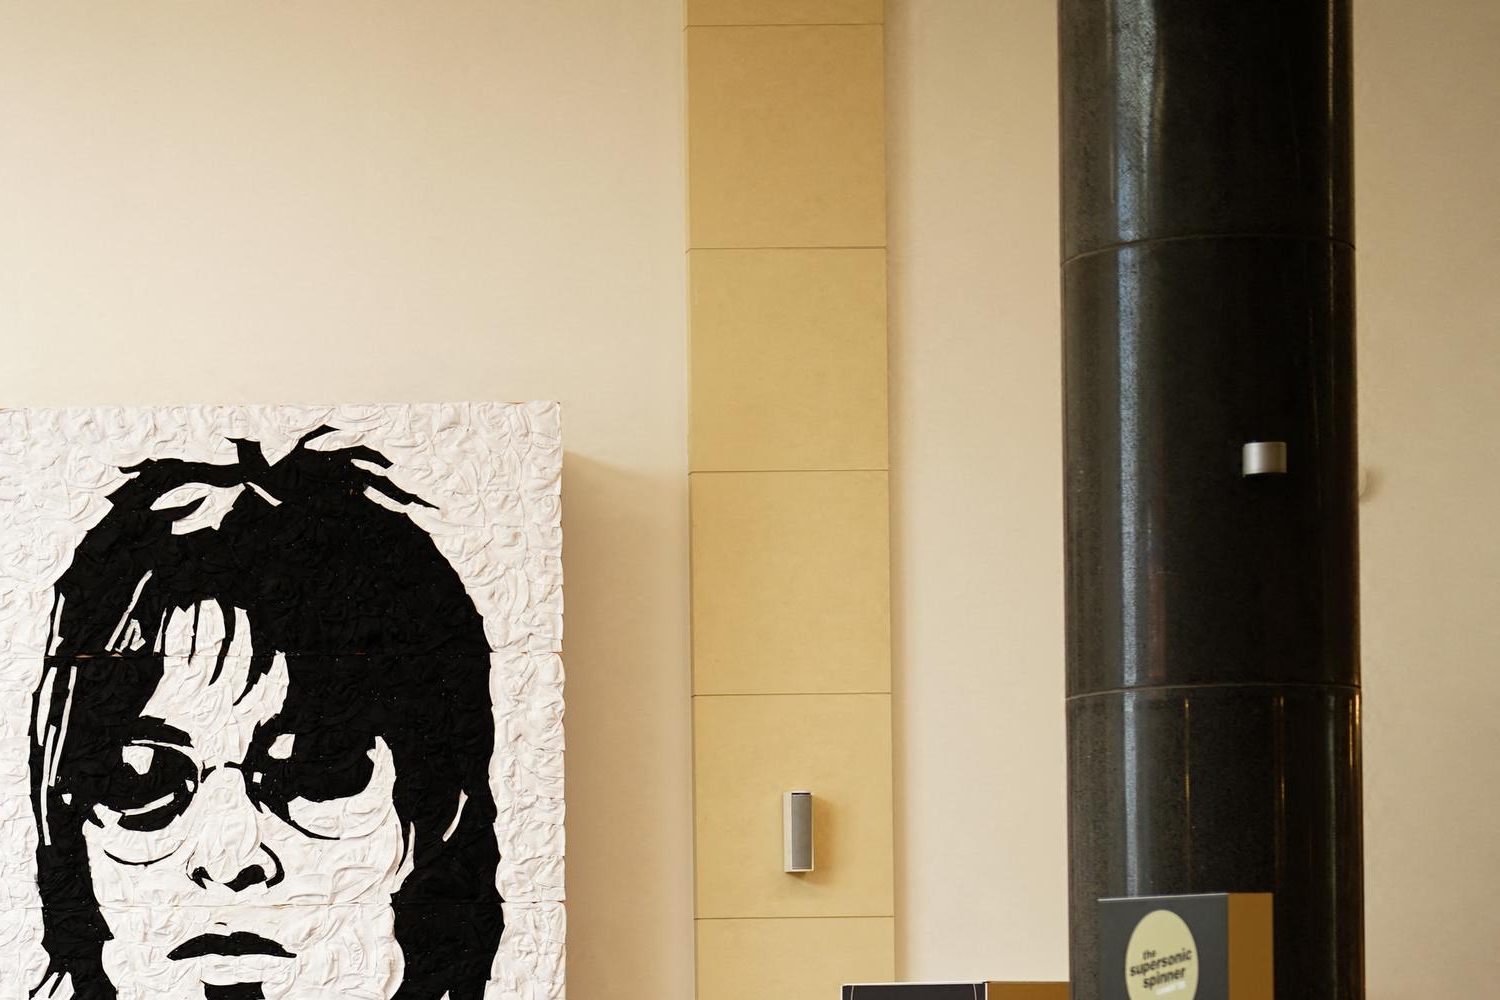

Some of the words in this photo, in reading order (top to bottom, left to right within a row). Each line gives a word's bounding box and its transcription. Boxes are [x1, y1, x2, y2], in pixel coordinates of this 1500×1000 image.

[1130, 948, 1192, 976] supersonic
[1142, 950, 1157, 960] the
[1143, 967, 1186, 990] spinner
